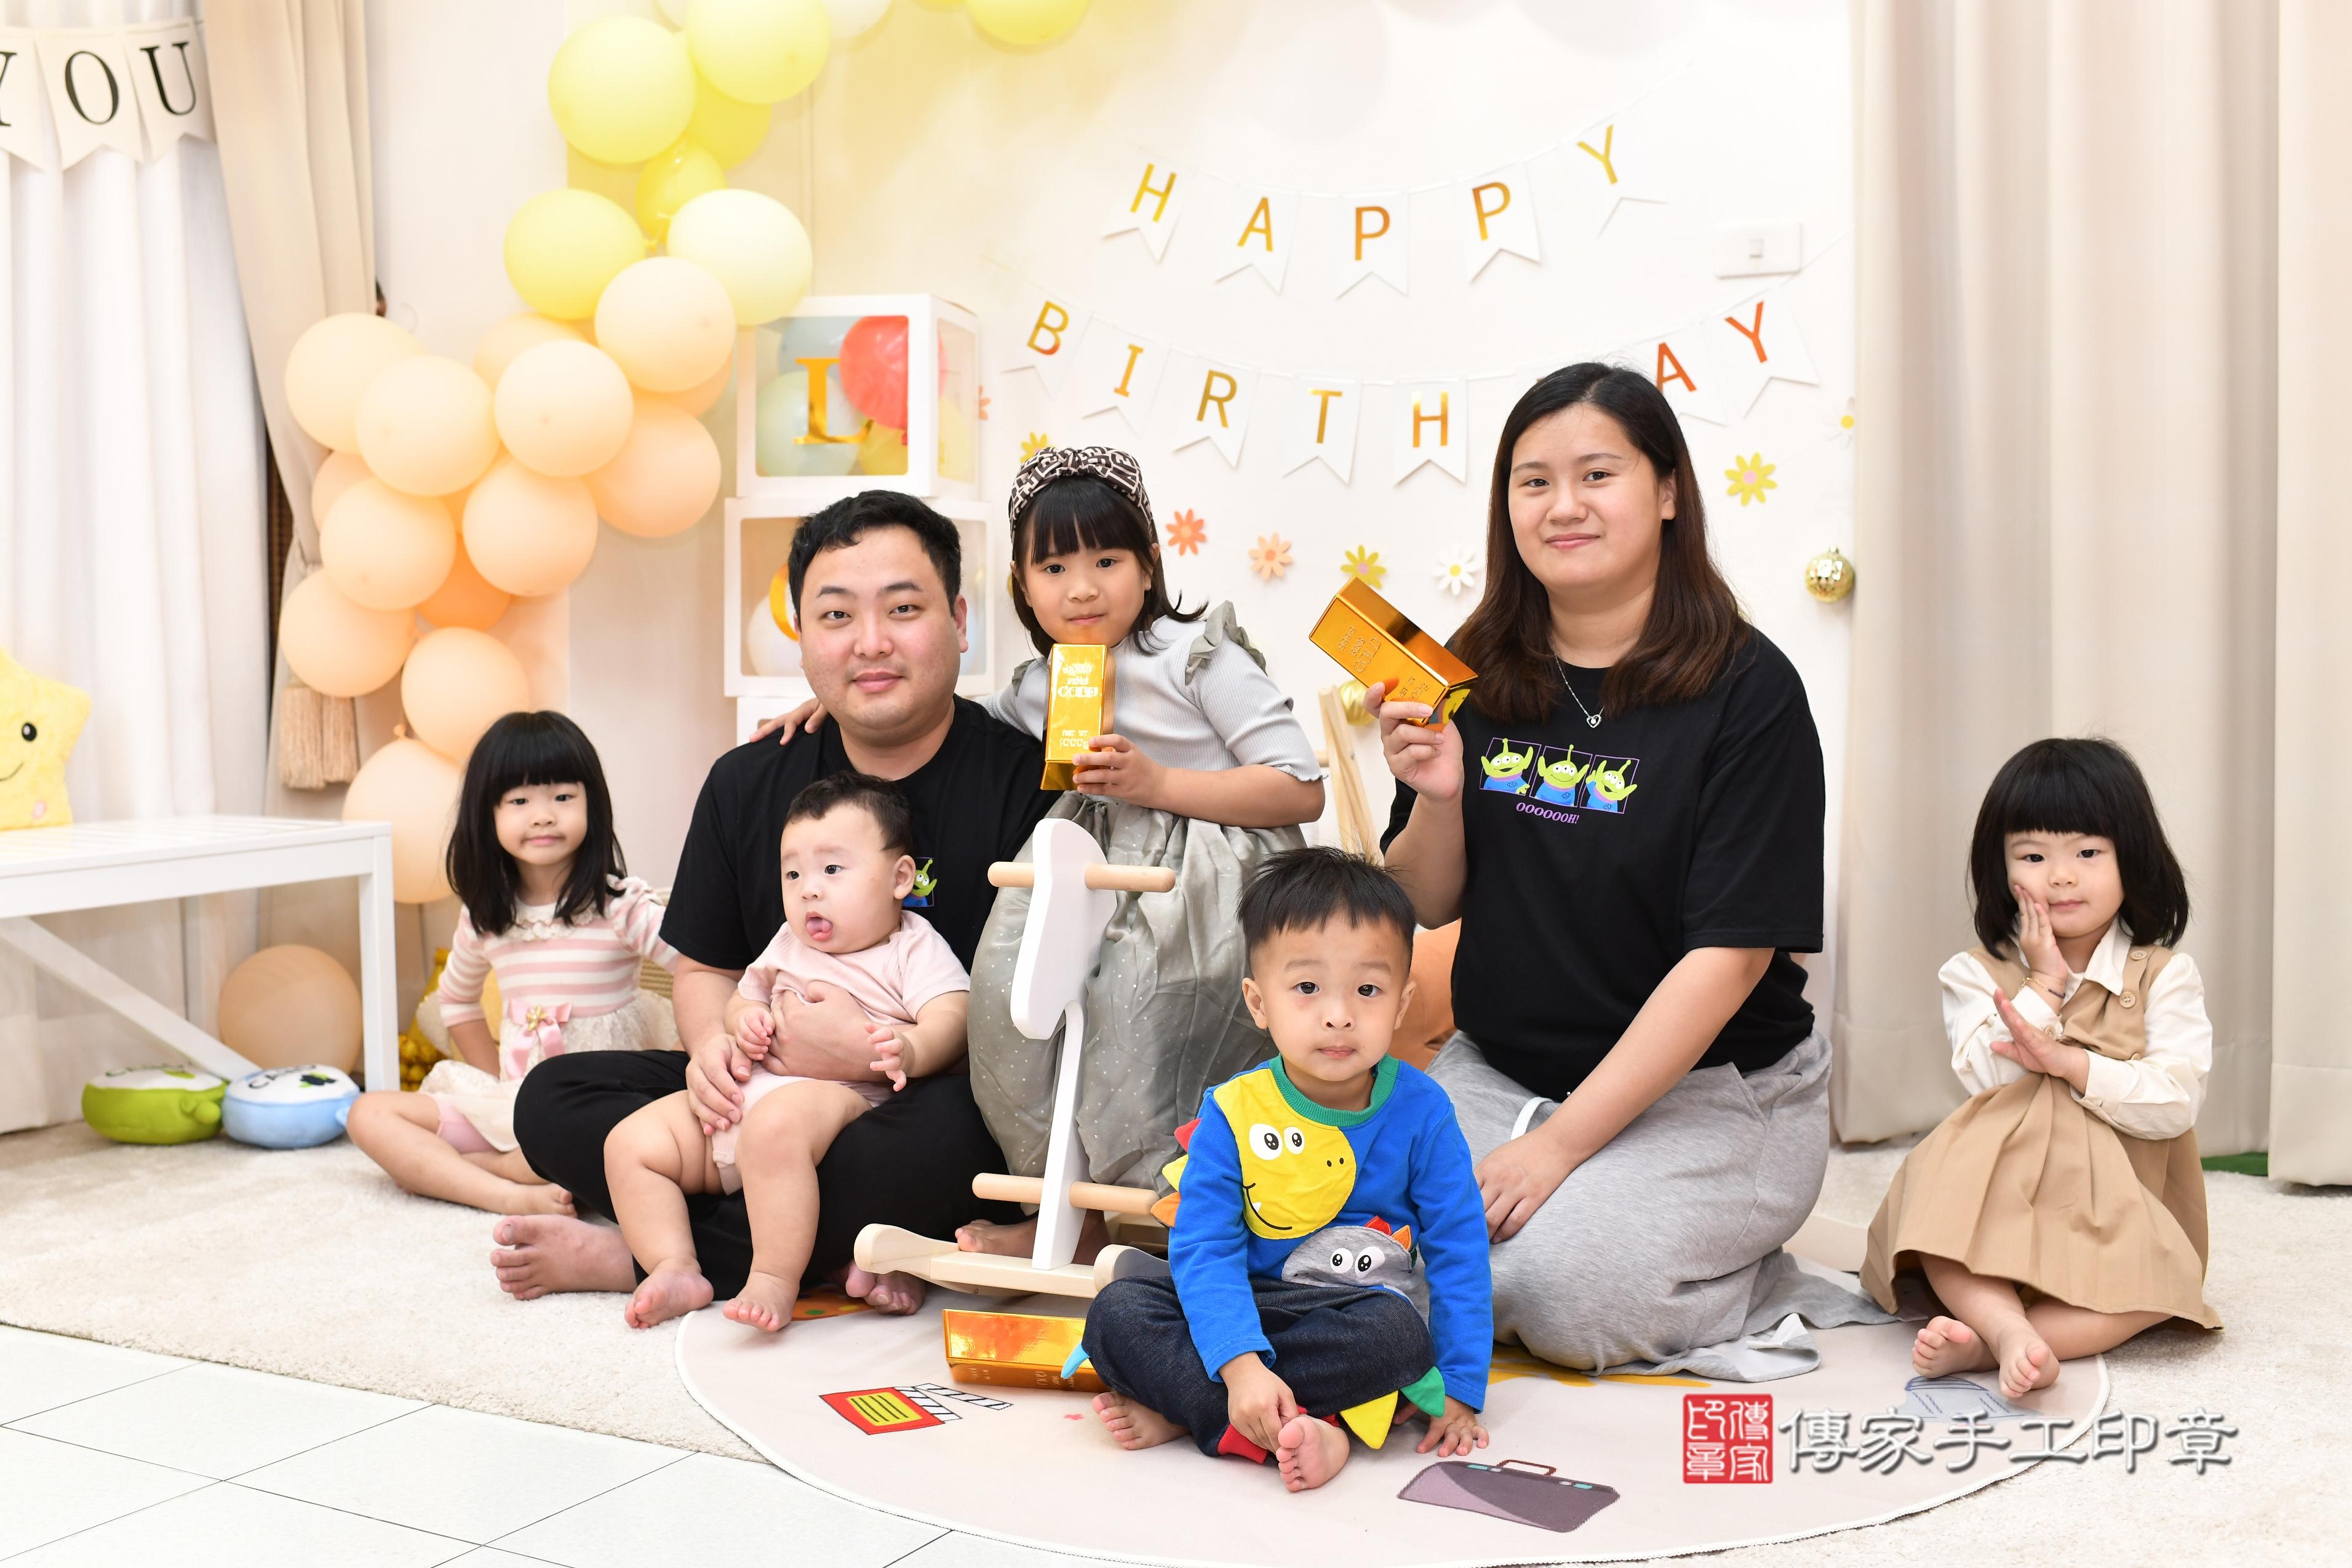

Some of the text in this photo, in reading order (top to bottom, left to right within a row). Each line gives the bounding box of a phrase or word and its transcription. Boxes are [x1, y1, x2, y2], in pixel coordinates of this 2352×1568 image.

[1129, 124, 1618, 261] HAPPY
[793, 357, 875, 444] L
[1026, 300, 1768, 448] BIRTHAY
[1354, 636, 1381, 672] GOLD
[1058, 686, 1098, 698] GOLD
[1516, 802, 1580, 824] OOOOOOH!
